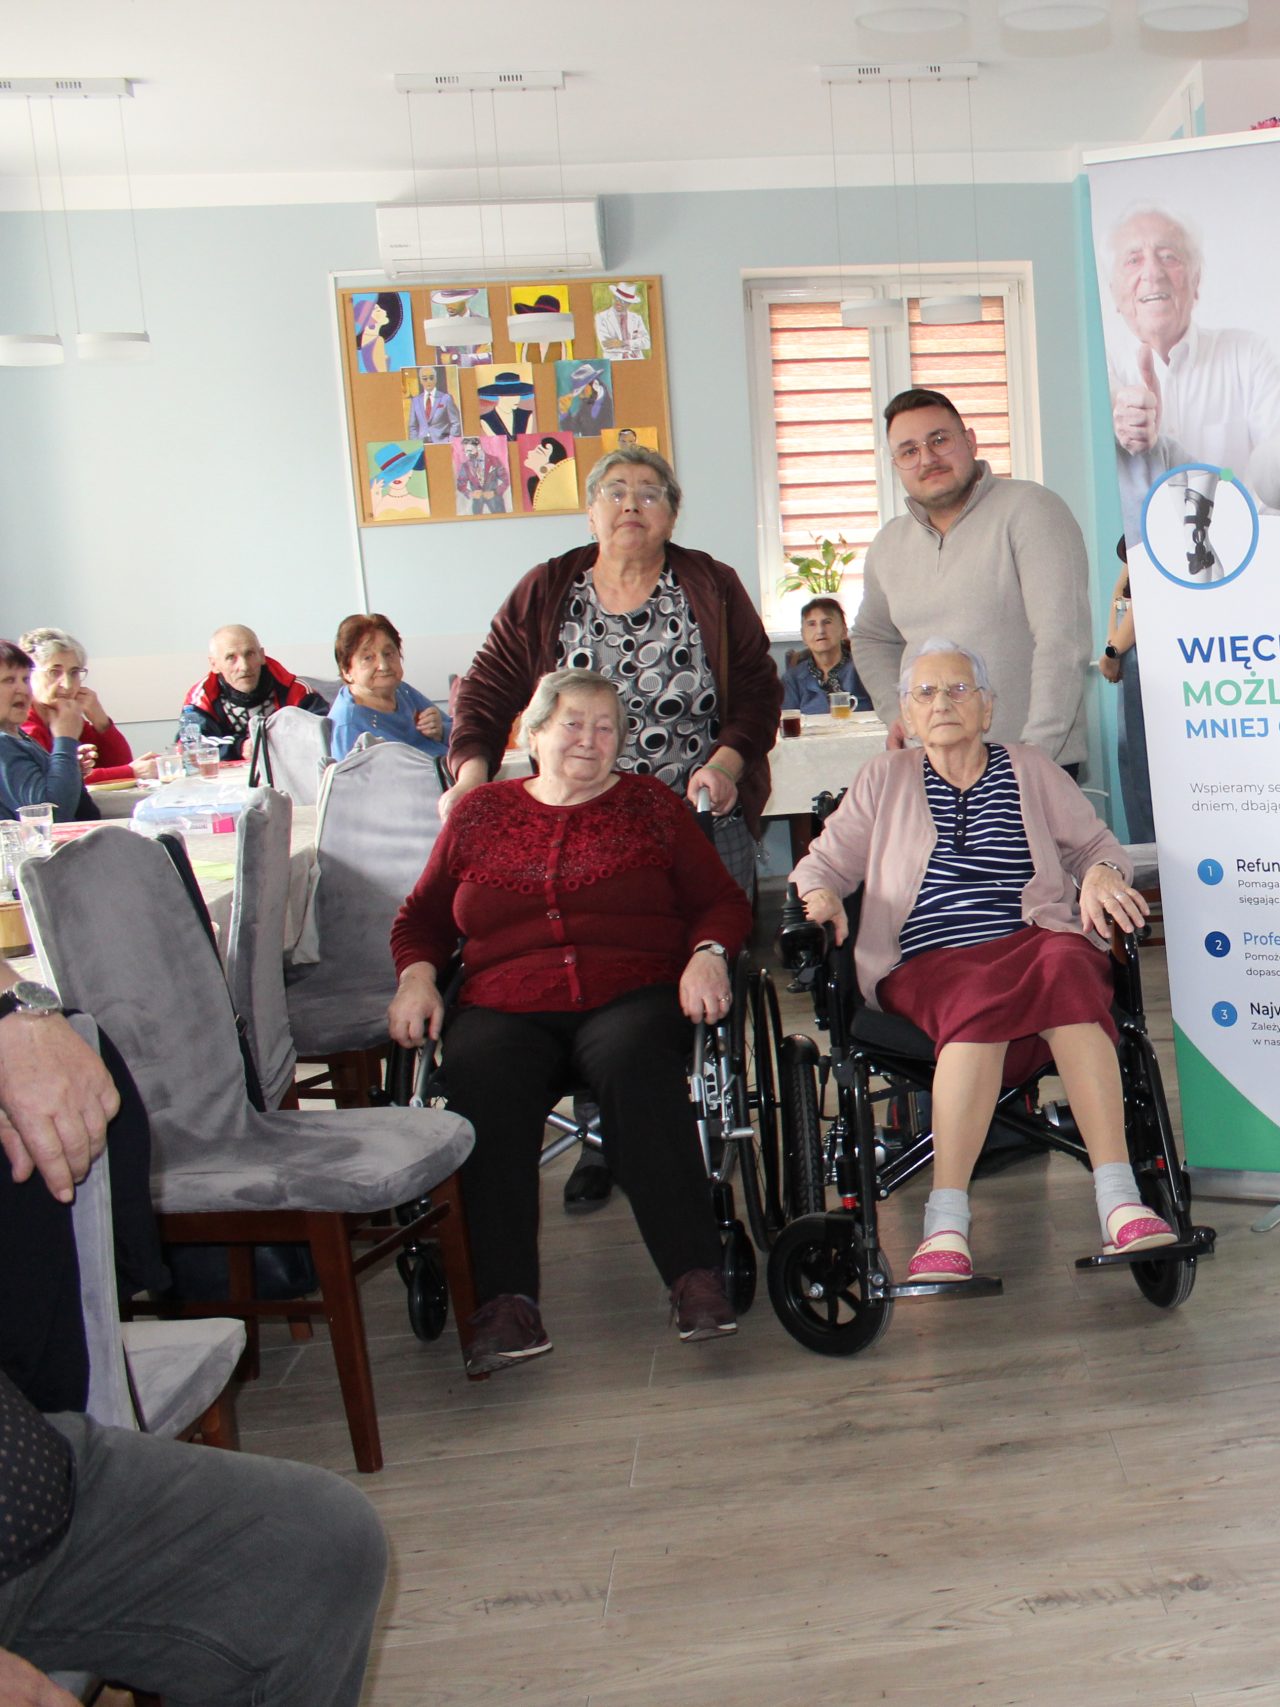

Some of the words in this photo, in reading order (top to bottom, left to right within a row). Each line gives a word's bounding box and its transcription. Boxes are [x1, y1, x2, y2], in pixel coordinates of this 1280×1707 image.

[1185, 717, 1270, 739] MNIEJ
[1190, 782, 1265, 796] Wspieramy
[1191, 800, 1238, 813] dniem,
[1207, 865, 1213, 877] 1
[1214, 939, 1223, 951] 2
[1220, 1009, 1228, 1020] 3
